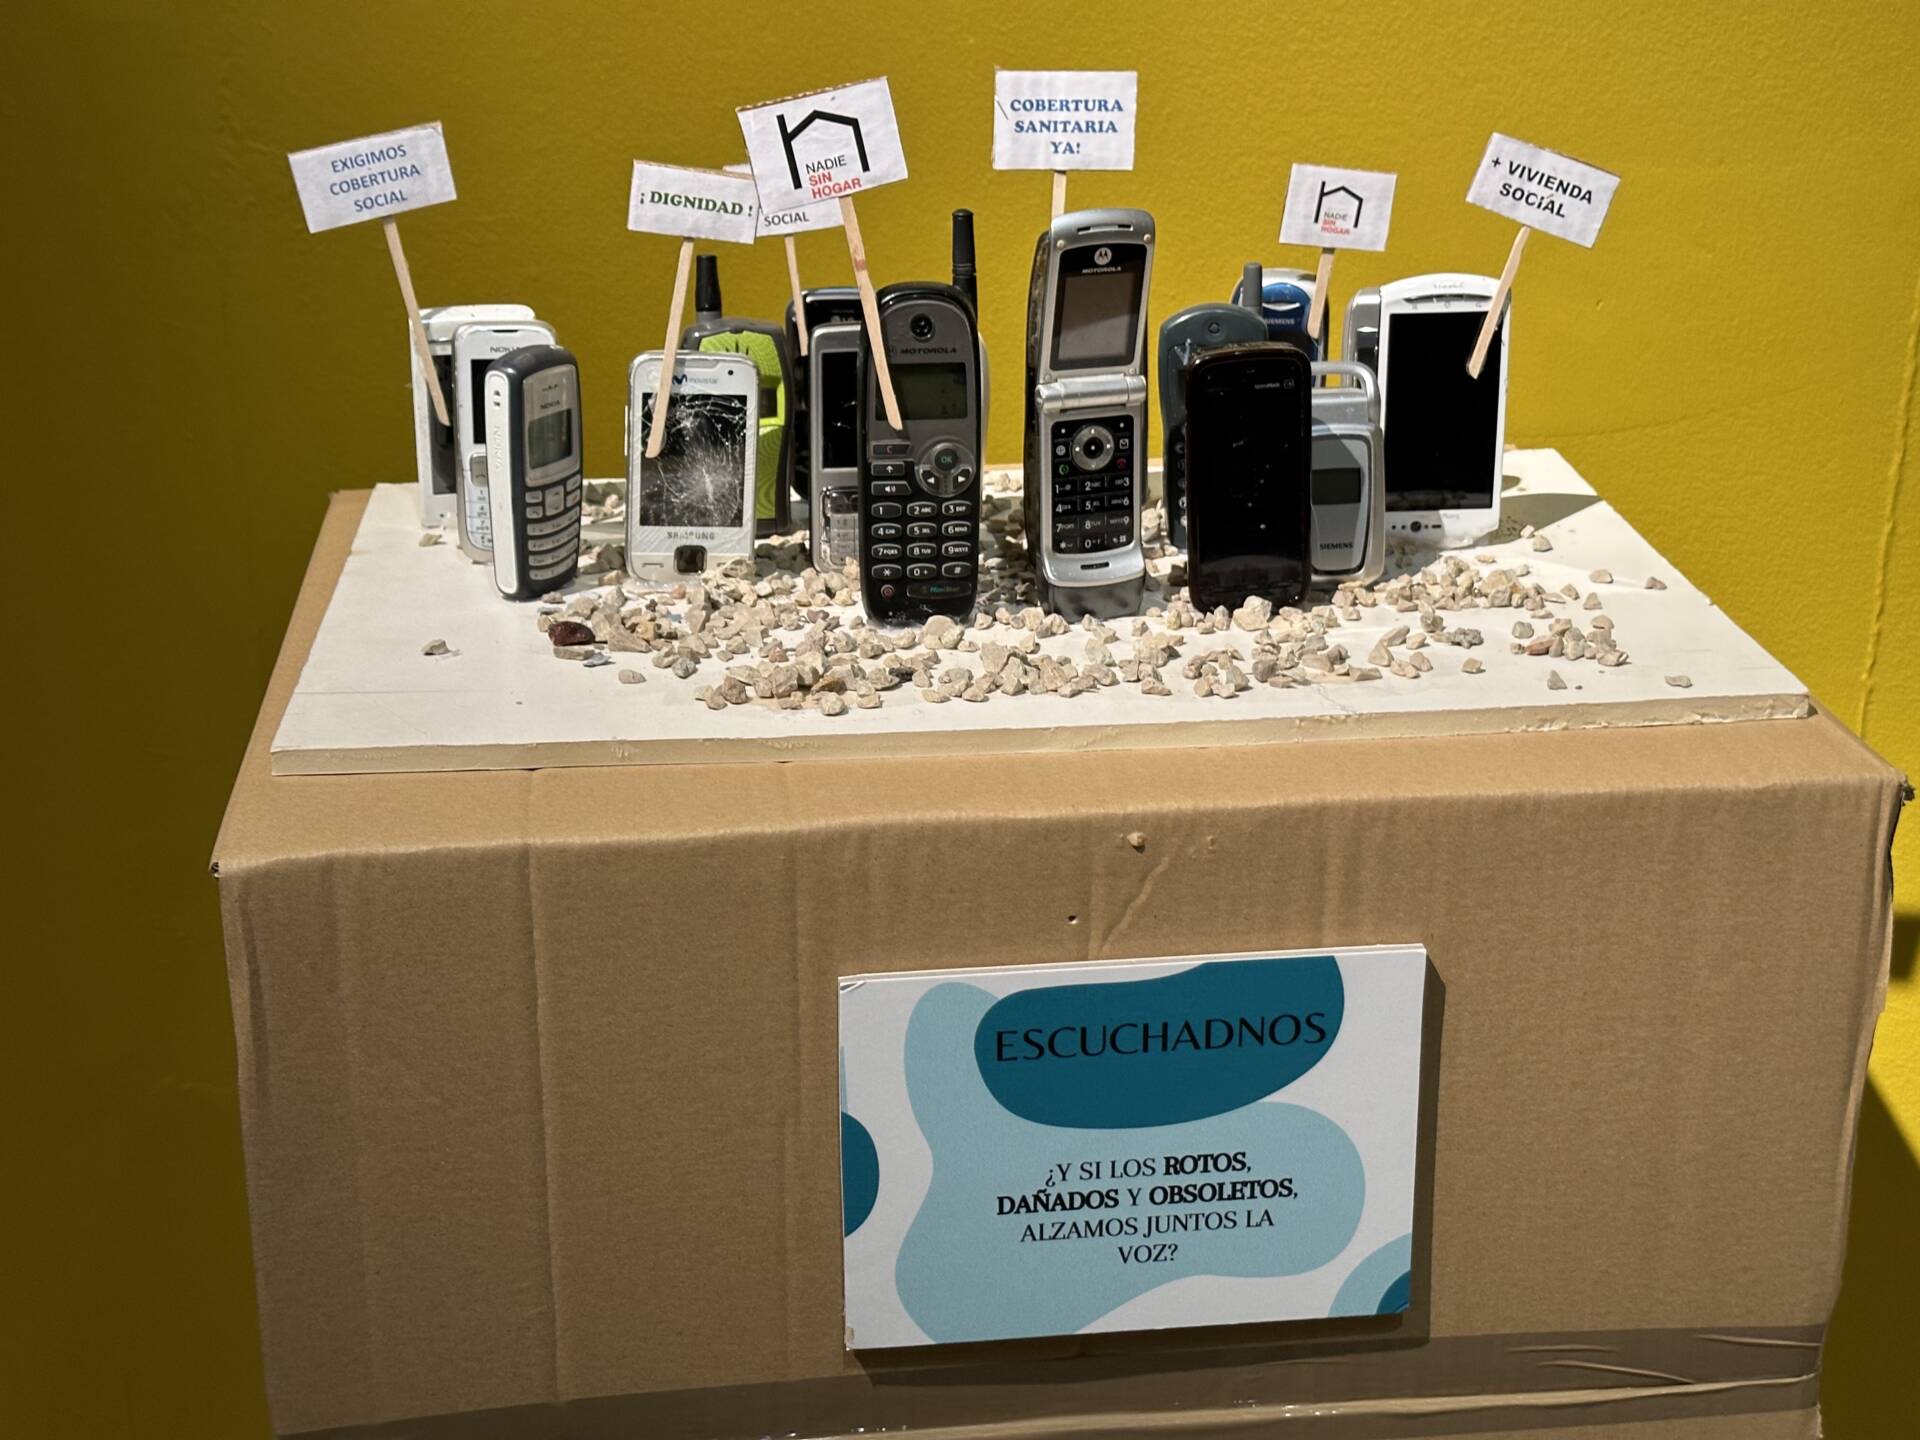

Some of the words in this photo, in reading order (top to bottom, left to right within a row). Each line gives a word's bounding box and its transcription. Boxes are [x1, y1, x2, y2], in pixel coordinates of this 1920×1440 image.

[1010, 99, 1123, 112] COBERTURA
[1014, 120, 1118, 133] SANITARIA
[1050, 141, 1081, 154] YA!
[331, 144, 407, 173] EXIGIMOS
[805, 154, 847, 174] NADIE
[329, 163, 421, 196] COBERTURA
[808, 172, 833, 187] SIN
[812, 177, 862, 199] HOGAR
[1508, 160, 1593, 204] VIVIENDA
[354, 190, 408, 212] SOCIAL
[764, 211, 810, 227] SOCIAL
[1323, 211, 1348, 221] NADIE
[1321, 226, 1351, 235] HOGAR
[1082, 266, 1122, 274] MOTOROLA
[940, 456, 953, 464] OK
[1320, 542, 1353, 550] SIEMENS
[995, 1011, 1327, 1063] ESCUCHADNOS
[1045, 1162, 1072, 1187] ¿Y
[1079, 1161, 1101, 1181] SI
[1110, 1158, 1156, 1179] LOS
[1163, 1152, 1252, 1176] ROTOS,
[996, 1188, 1119, 1215] DAÑADOS
[1126, 1188, 1142, 1206] Y
[1149, 1178, 1298, 1205] OBSOLETOS,
[1020, 1217, 1138, 1242] ALZAMOS
[1142, 1210, 1238, 1238] JUNTOS
[1246, 1209, 1275, 1228] LA
[1118, 1243, 1179, 1264] VOZ?
